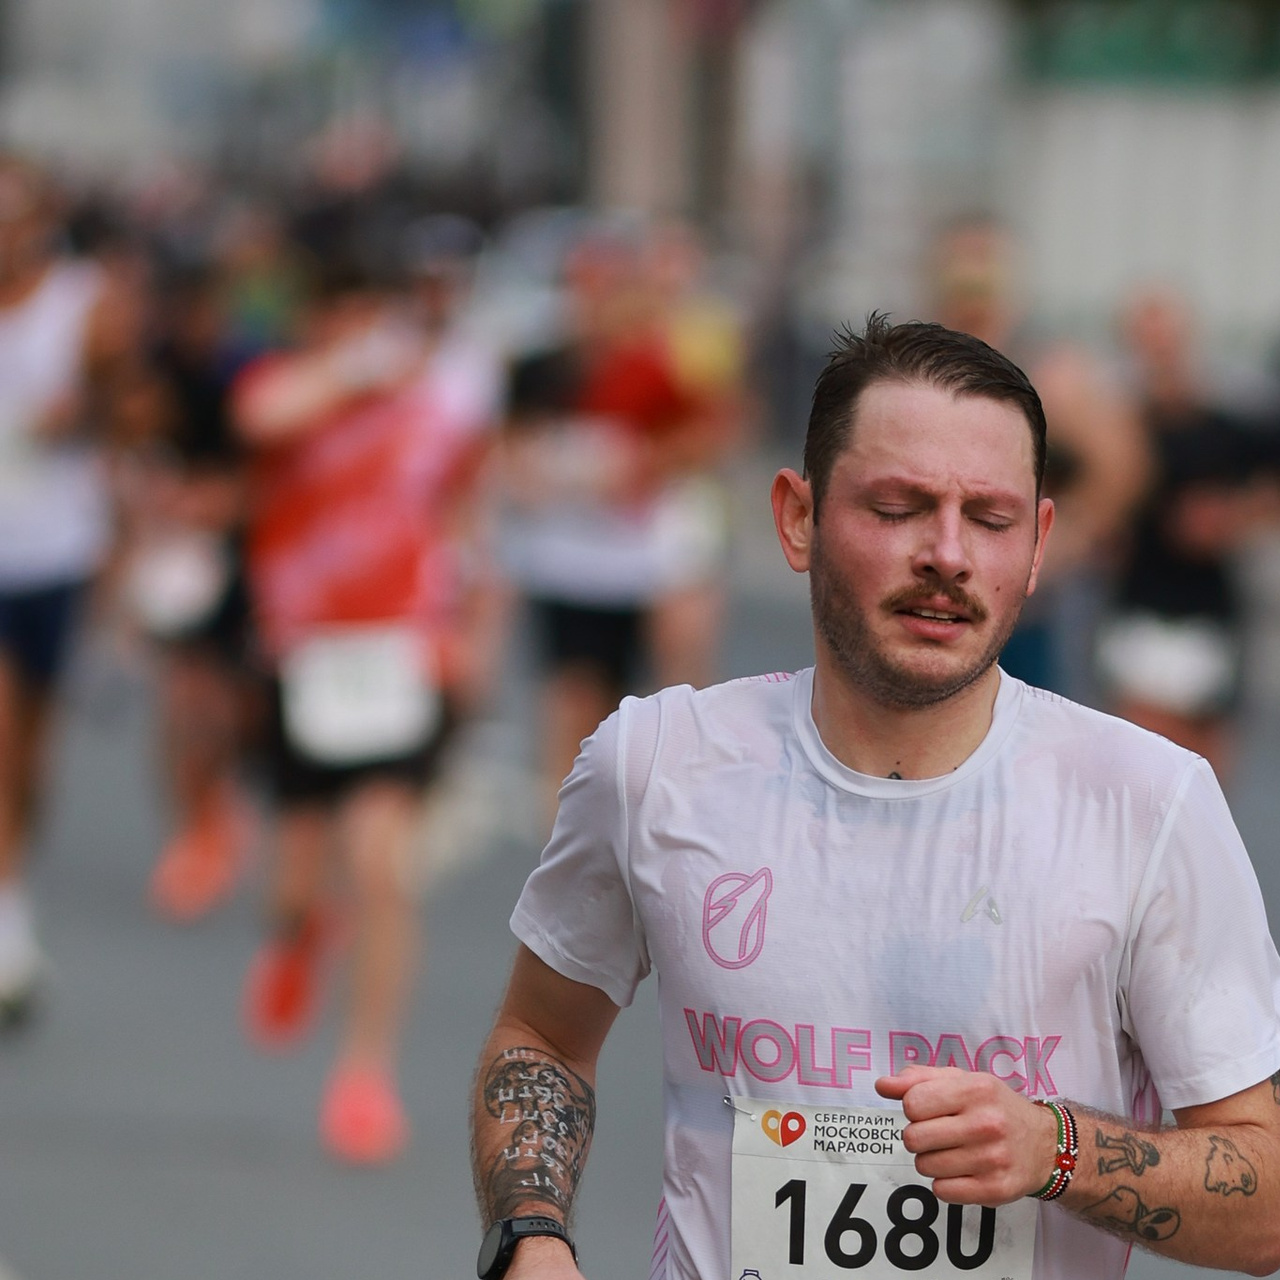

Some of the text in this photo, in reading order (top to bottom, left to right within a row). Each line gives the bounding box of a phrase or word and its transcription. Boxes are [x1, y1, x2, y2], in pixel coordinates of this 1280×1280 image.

[683, 1007, 1062, 1097] WOLF PACK
[814, 1113, 894, 1126] СБЕРПРАЙМ
[814, 1125, 904, 1141] МОСКОВСК
[814, 1139, 893, 1154] МАРАФОН
[775, 1178, 997, 1271] 1680
